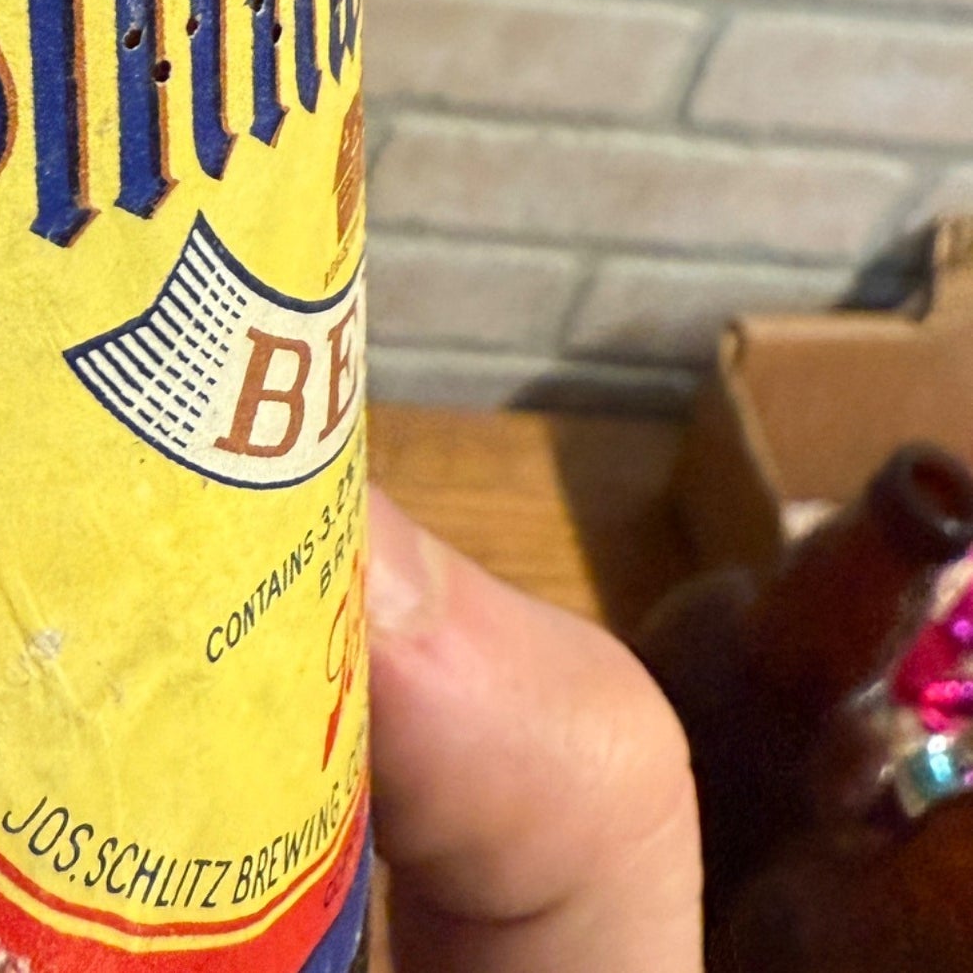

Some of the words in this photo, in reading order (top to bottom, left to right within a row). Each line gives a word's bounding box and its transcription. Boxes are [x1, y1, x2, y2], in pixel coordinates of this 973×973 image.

[206, 529, 315, 663] CONTAINS
[2, 796, 94, 882] JOS.
[84, 837, 232, 908] SCHLITZ
[231, 781, 340, 904] BREWING
